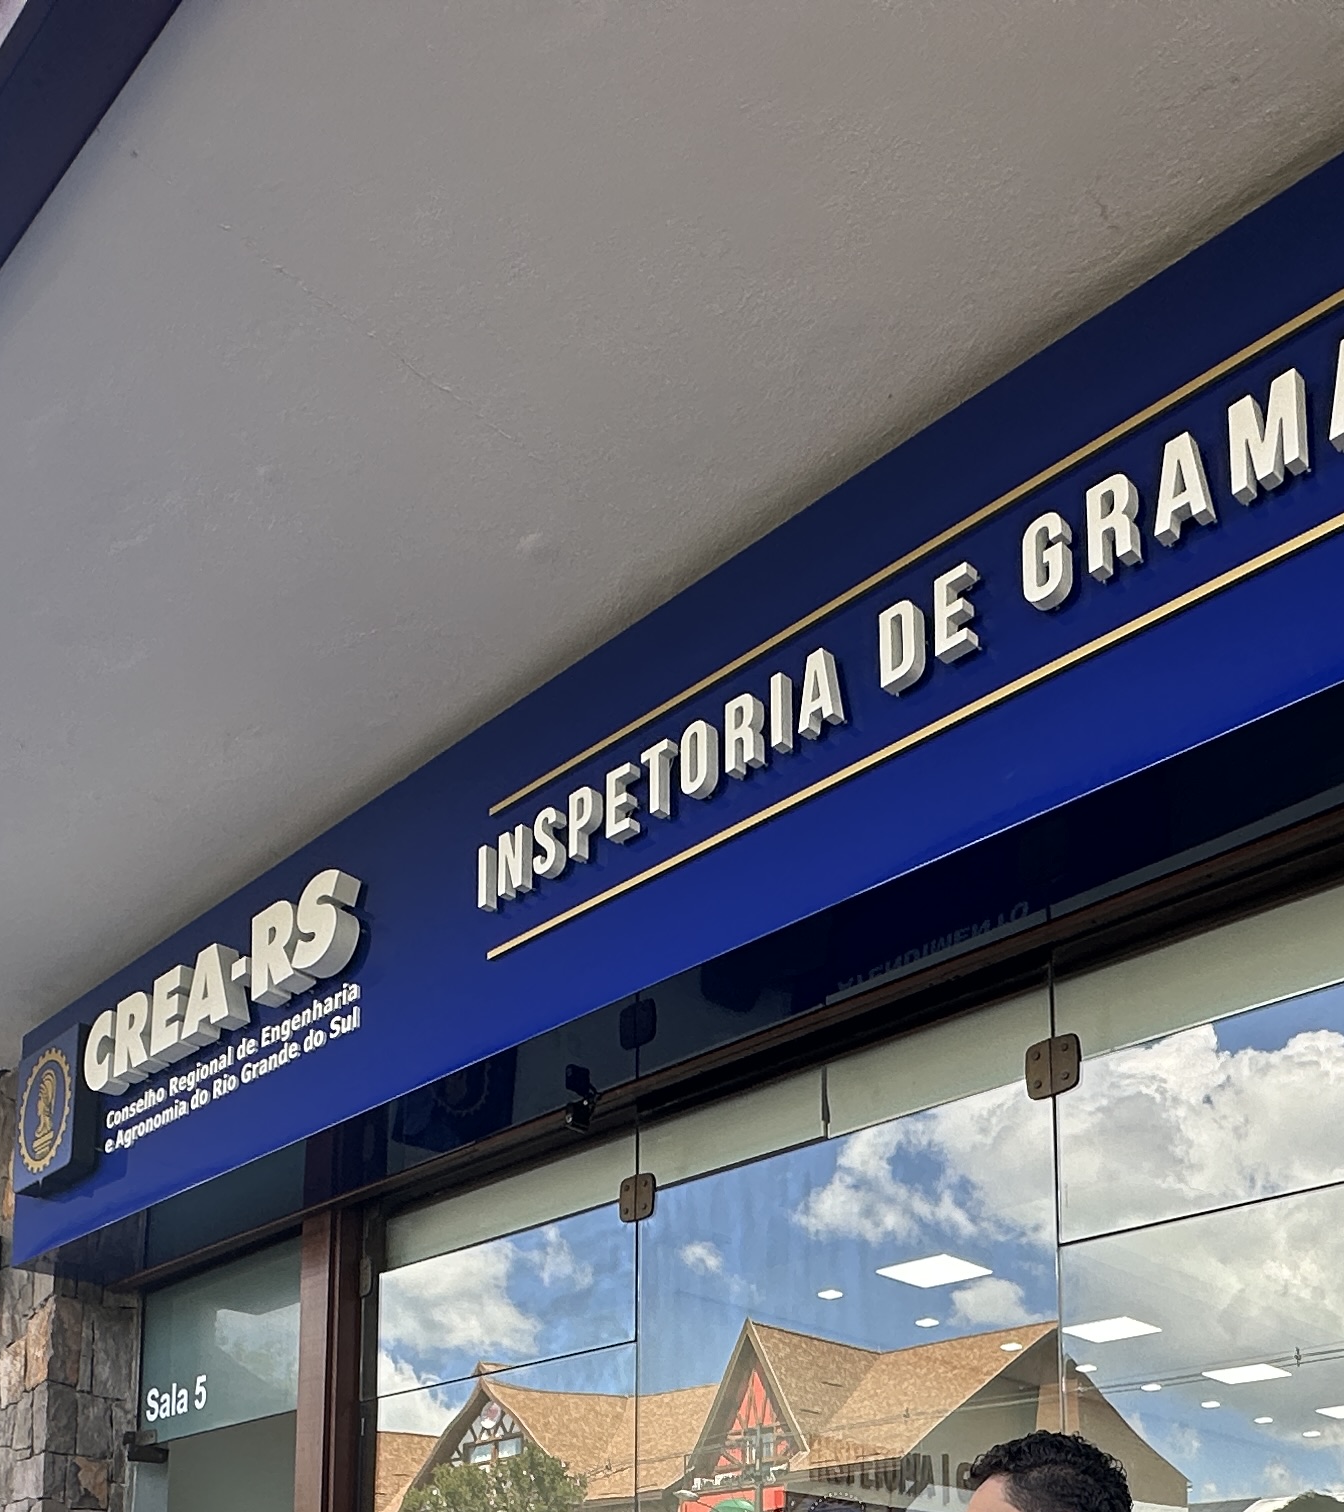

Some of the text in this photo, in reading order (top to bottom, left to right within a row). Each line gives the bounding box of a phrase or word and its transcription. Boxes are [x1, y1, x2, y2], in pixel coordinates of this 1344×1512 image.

[477, 647, 847, 911] INSPETORIA
[877, 560, 982, 696] DE
[83, 869, 362, 1095] CREA-RS
[106, 982, 361, 1129] Conselho Regional de Engenharia
[104, 1005, 361, 1154] e Agronomia do Rio Grande do Sul
[146, 1374, 207, 1422] Sala 5
